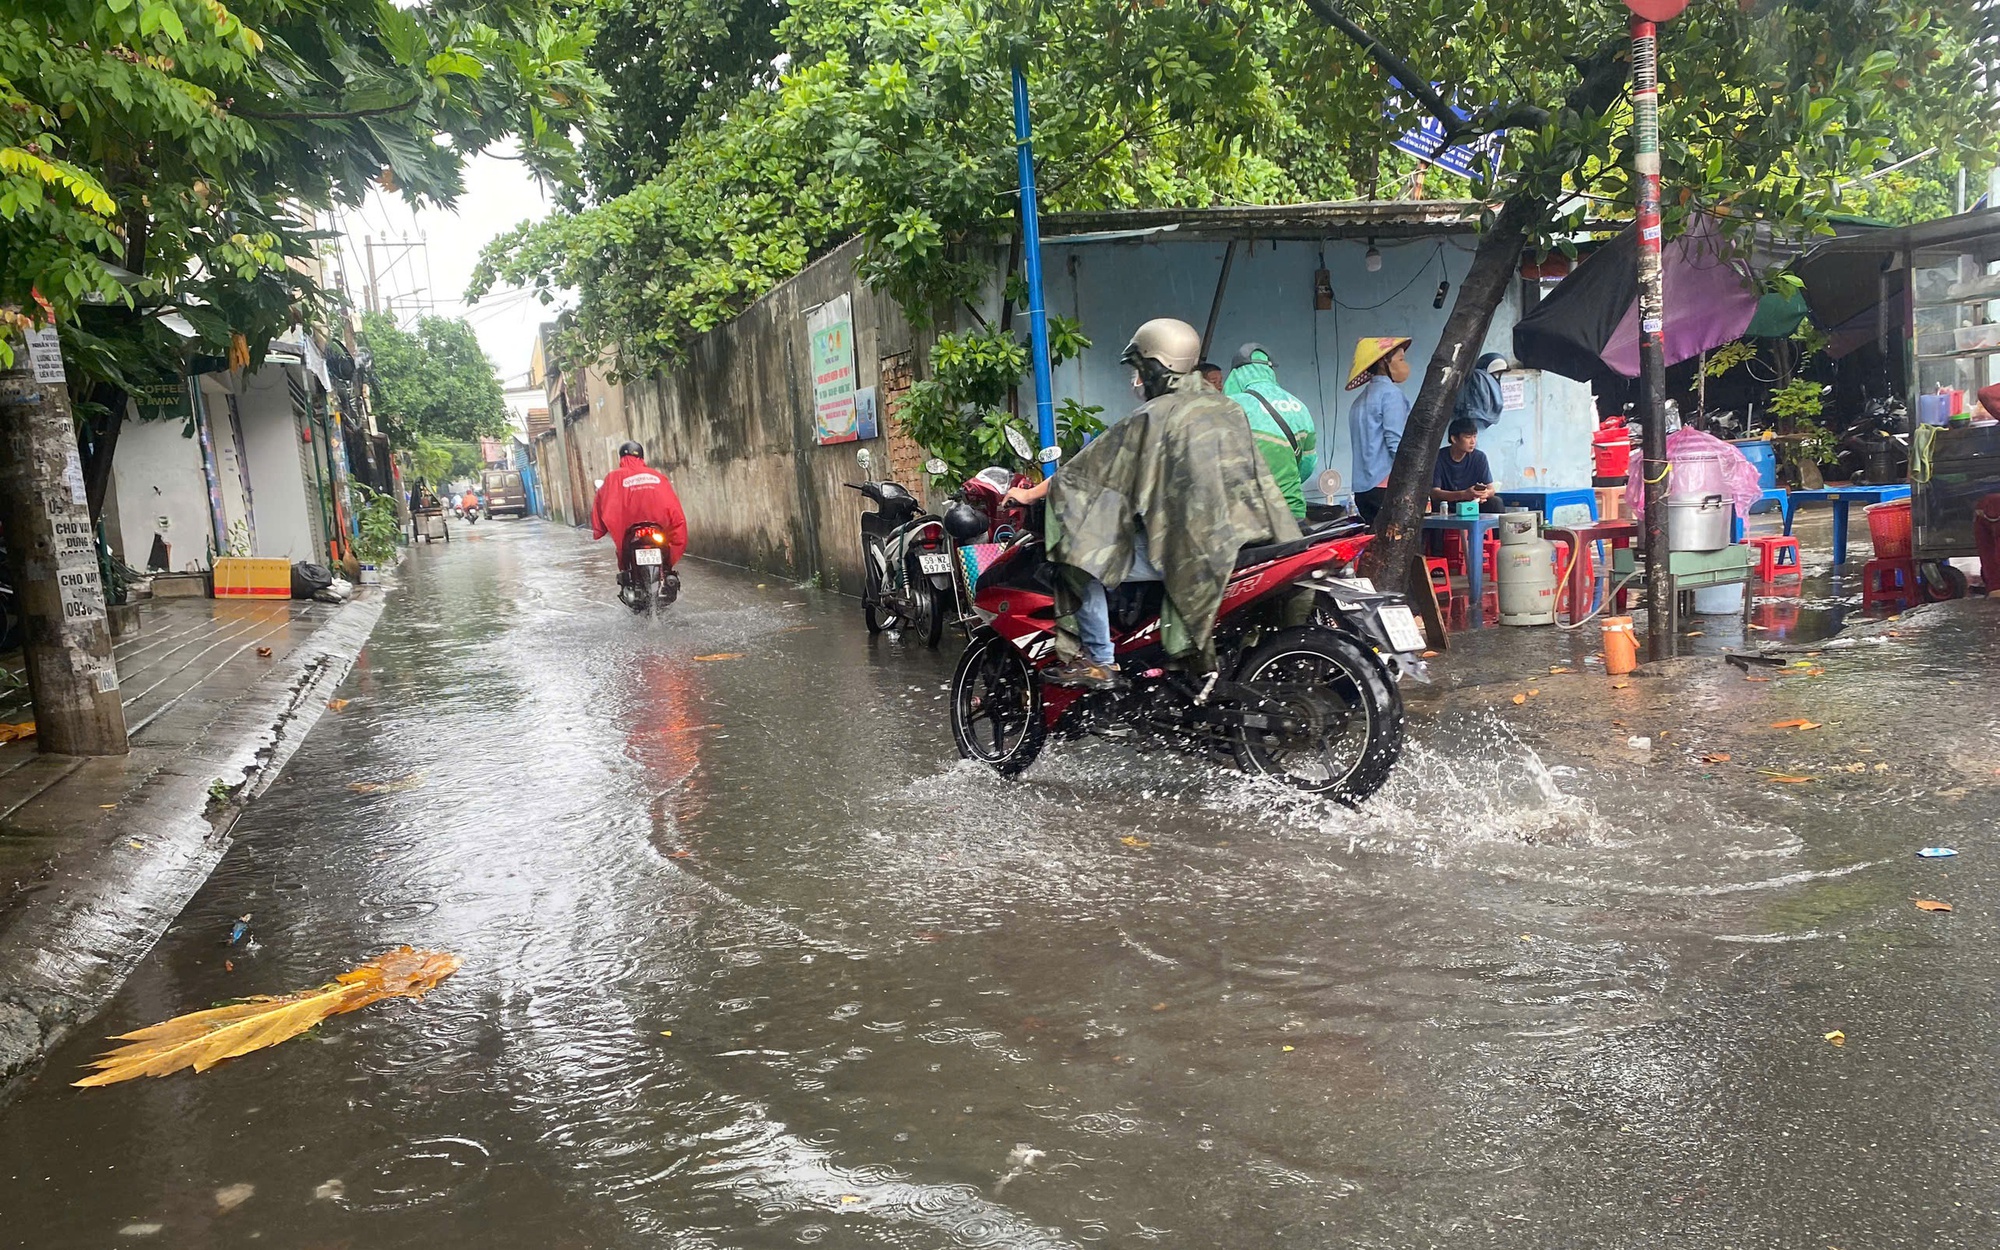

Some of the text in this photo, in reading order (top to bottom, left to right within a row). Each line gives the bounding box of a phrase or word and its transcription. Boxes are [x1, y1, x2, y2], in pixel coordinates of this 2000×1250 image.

[147, 396, 180, 406] AWAY
[55, 522, 78, 535] CHO
[60, 573, 84, 587] CHO
